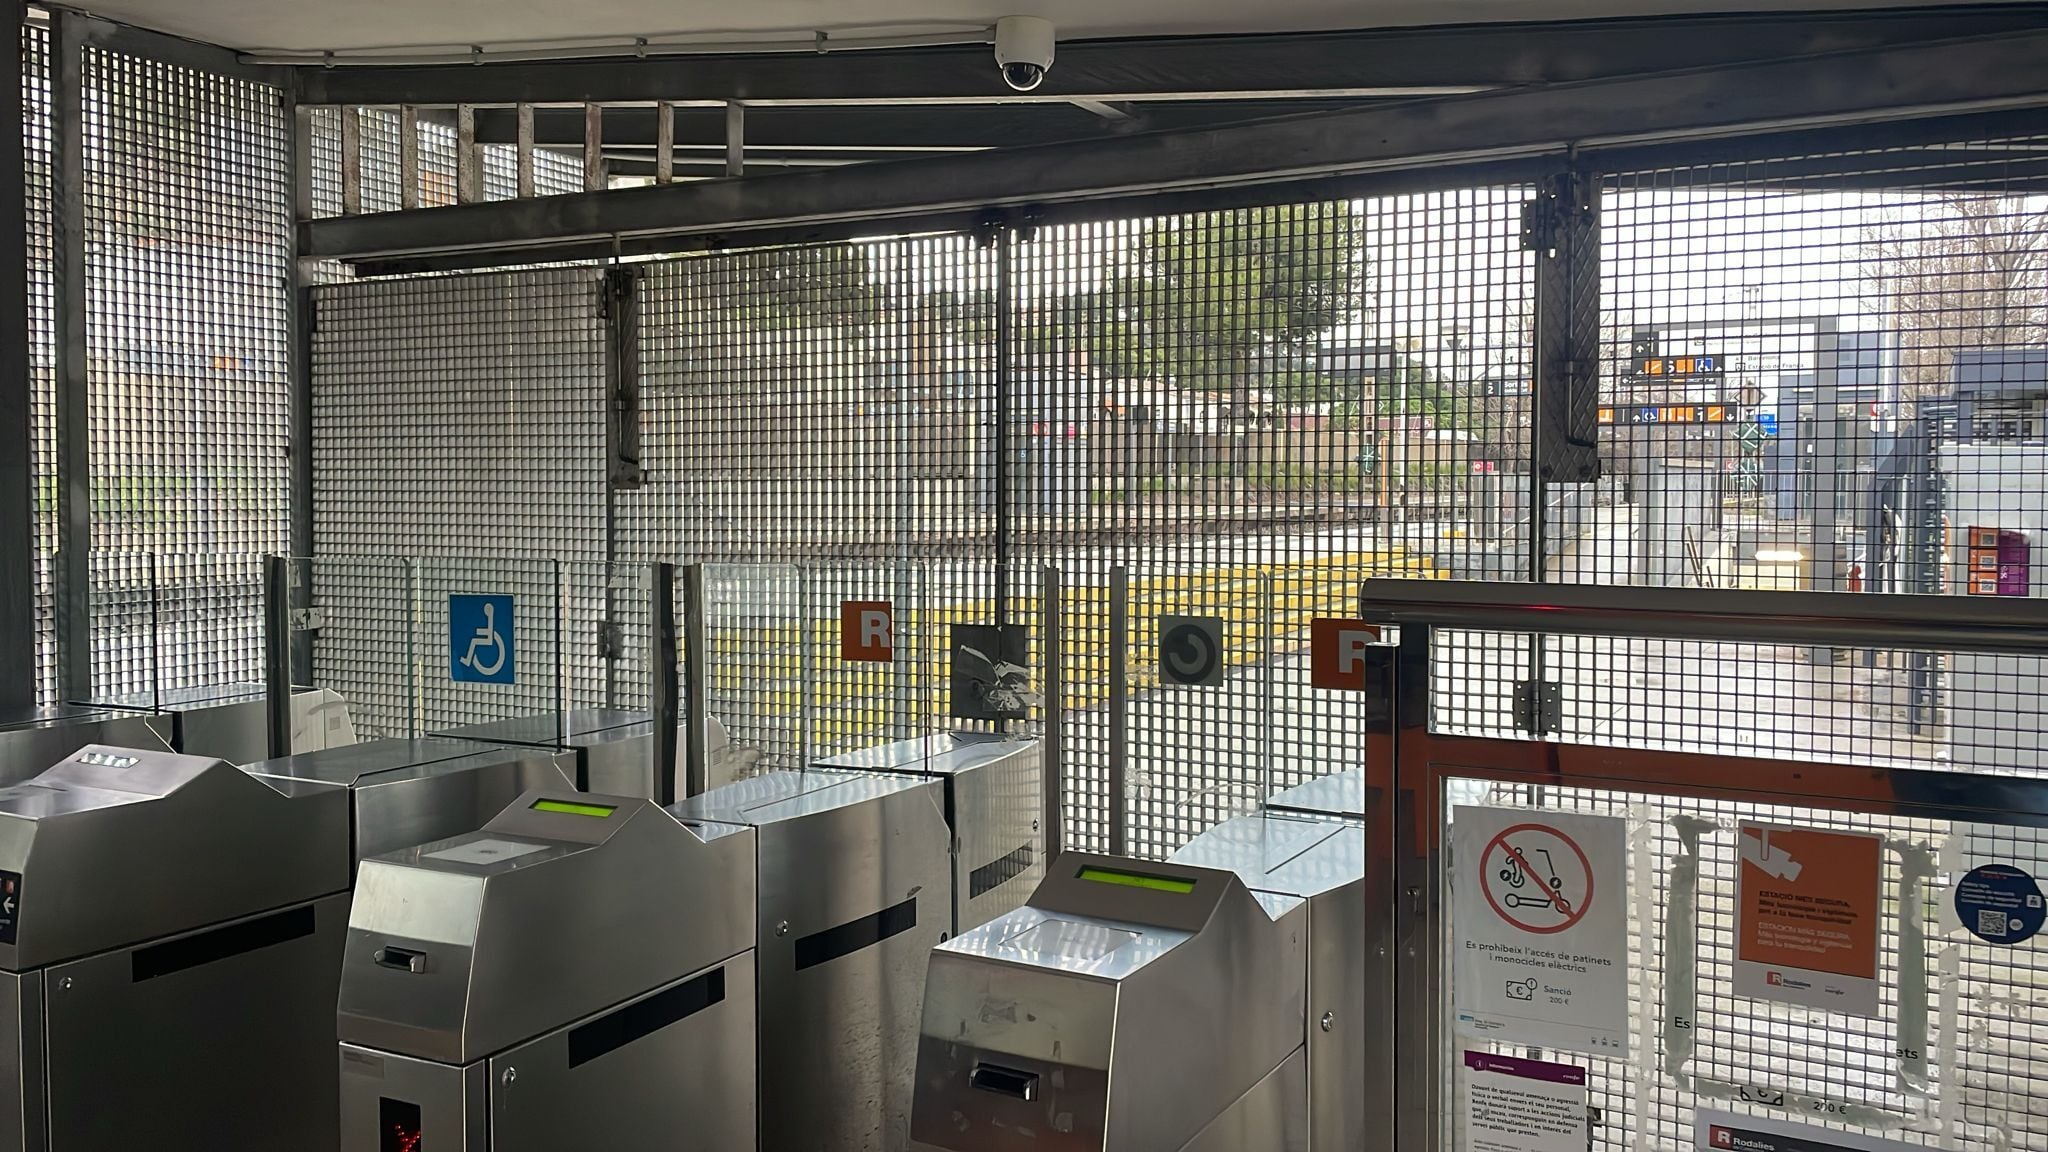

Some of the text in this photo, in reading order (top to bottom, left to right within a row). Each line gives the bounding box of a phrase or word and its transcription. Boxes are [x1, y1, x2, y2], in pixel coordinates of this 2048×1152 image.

[861, 611, 890, 648] R
[1466, 940, 1477, 949] Es
[1479, 942, 1522, 955] prohibeix
[1558, 951, 1570, 960] de
[1573, 954, 1611, 966] patinets
[1494, 955, 1545, 968] monocicles
[1548, 958, 1586, 973] elèctrics
[1543, 985, 1572, 996] Sanció
[1550, 996, 1562, 1005] 200
[1674, 1017, 1690, 1029] Es
[1839, 1105, 1846, 1114] €
[1717, 1130, 1731, 1144] R
[1733, 1137, 1774, 1151] Rodalies
